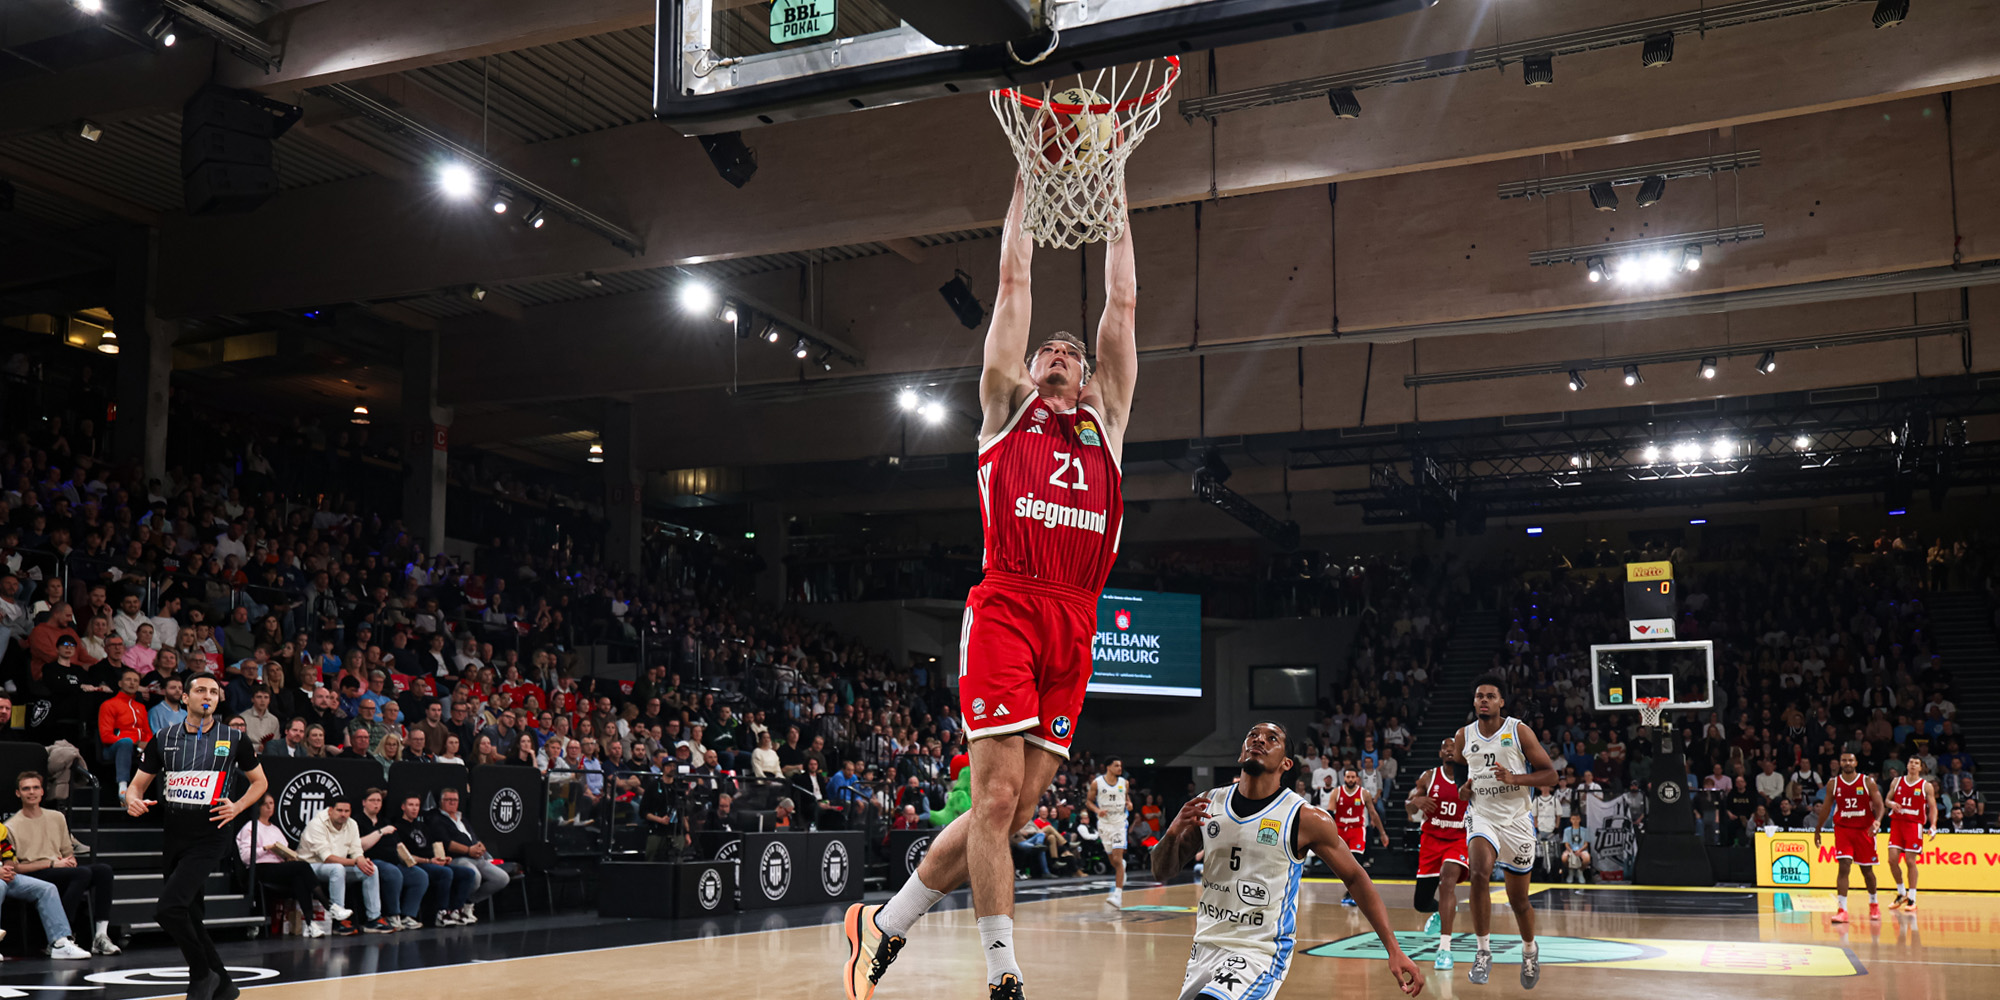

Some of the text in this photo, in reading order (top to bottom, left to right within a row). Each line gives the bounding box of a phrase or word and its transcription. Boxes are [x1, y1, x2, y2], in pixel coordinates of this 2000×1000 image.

[784, 3, 820, 23] BBL
[783, 19, 820, 37] POKAL
[437, 431, 445, 445] C
[1049, 451, 1088, 491] 21
[1015, 492, 1106, 535] siegmund
[1633, 566, 1664, 577] Netto
[1660, 581, 1670, 594] 0
[1094, 631, 1160, 648] PIELBANK
[1484, 753, 1496, 766] 22
[283, 774, 311, 806] VEOLIA
[1474, 784, 1520, 798] nexperia
[1845, 798, 1858, 808] 32
[1901, 797, 1912, 806] 11
[1346, 807, 1352, 816] 4
[1440, 802, 1457, 816] 50
[720, 844, 738, 860] OLIA
[1775, 842, 1805, 852] Netto
[1229, 846, 1242, 871] 5
[1780, 867, 1801, 875] BBL
[1780, 874, 1801, 882] POKAL
[1242, 884, 1266, 898] Dole
